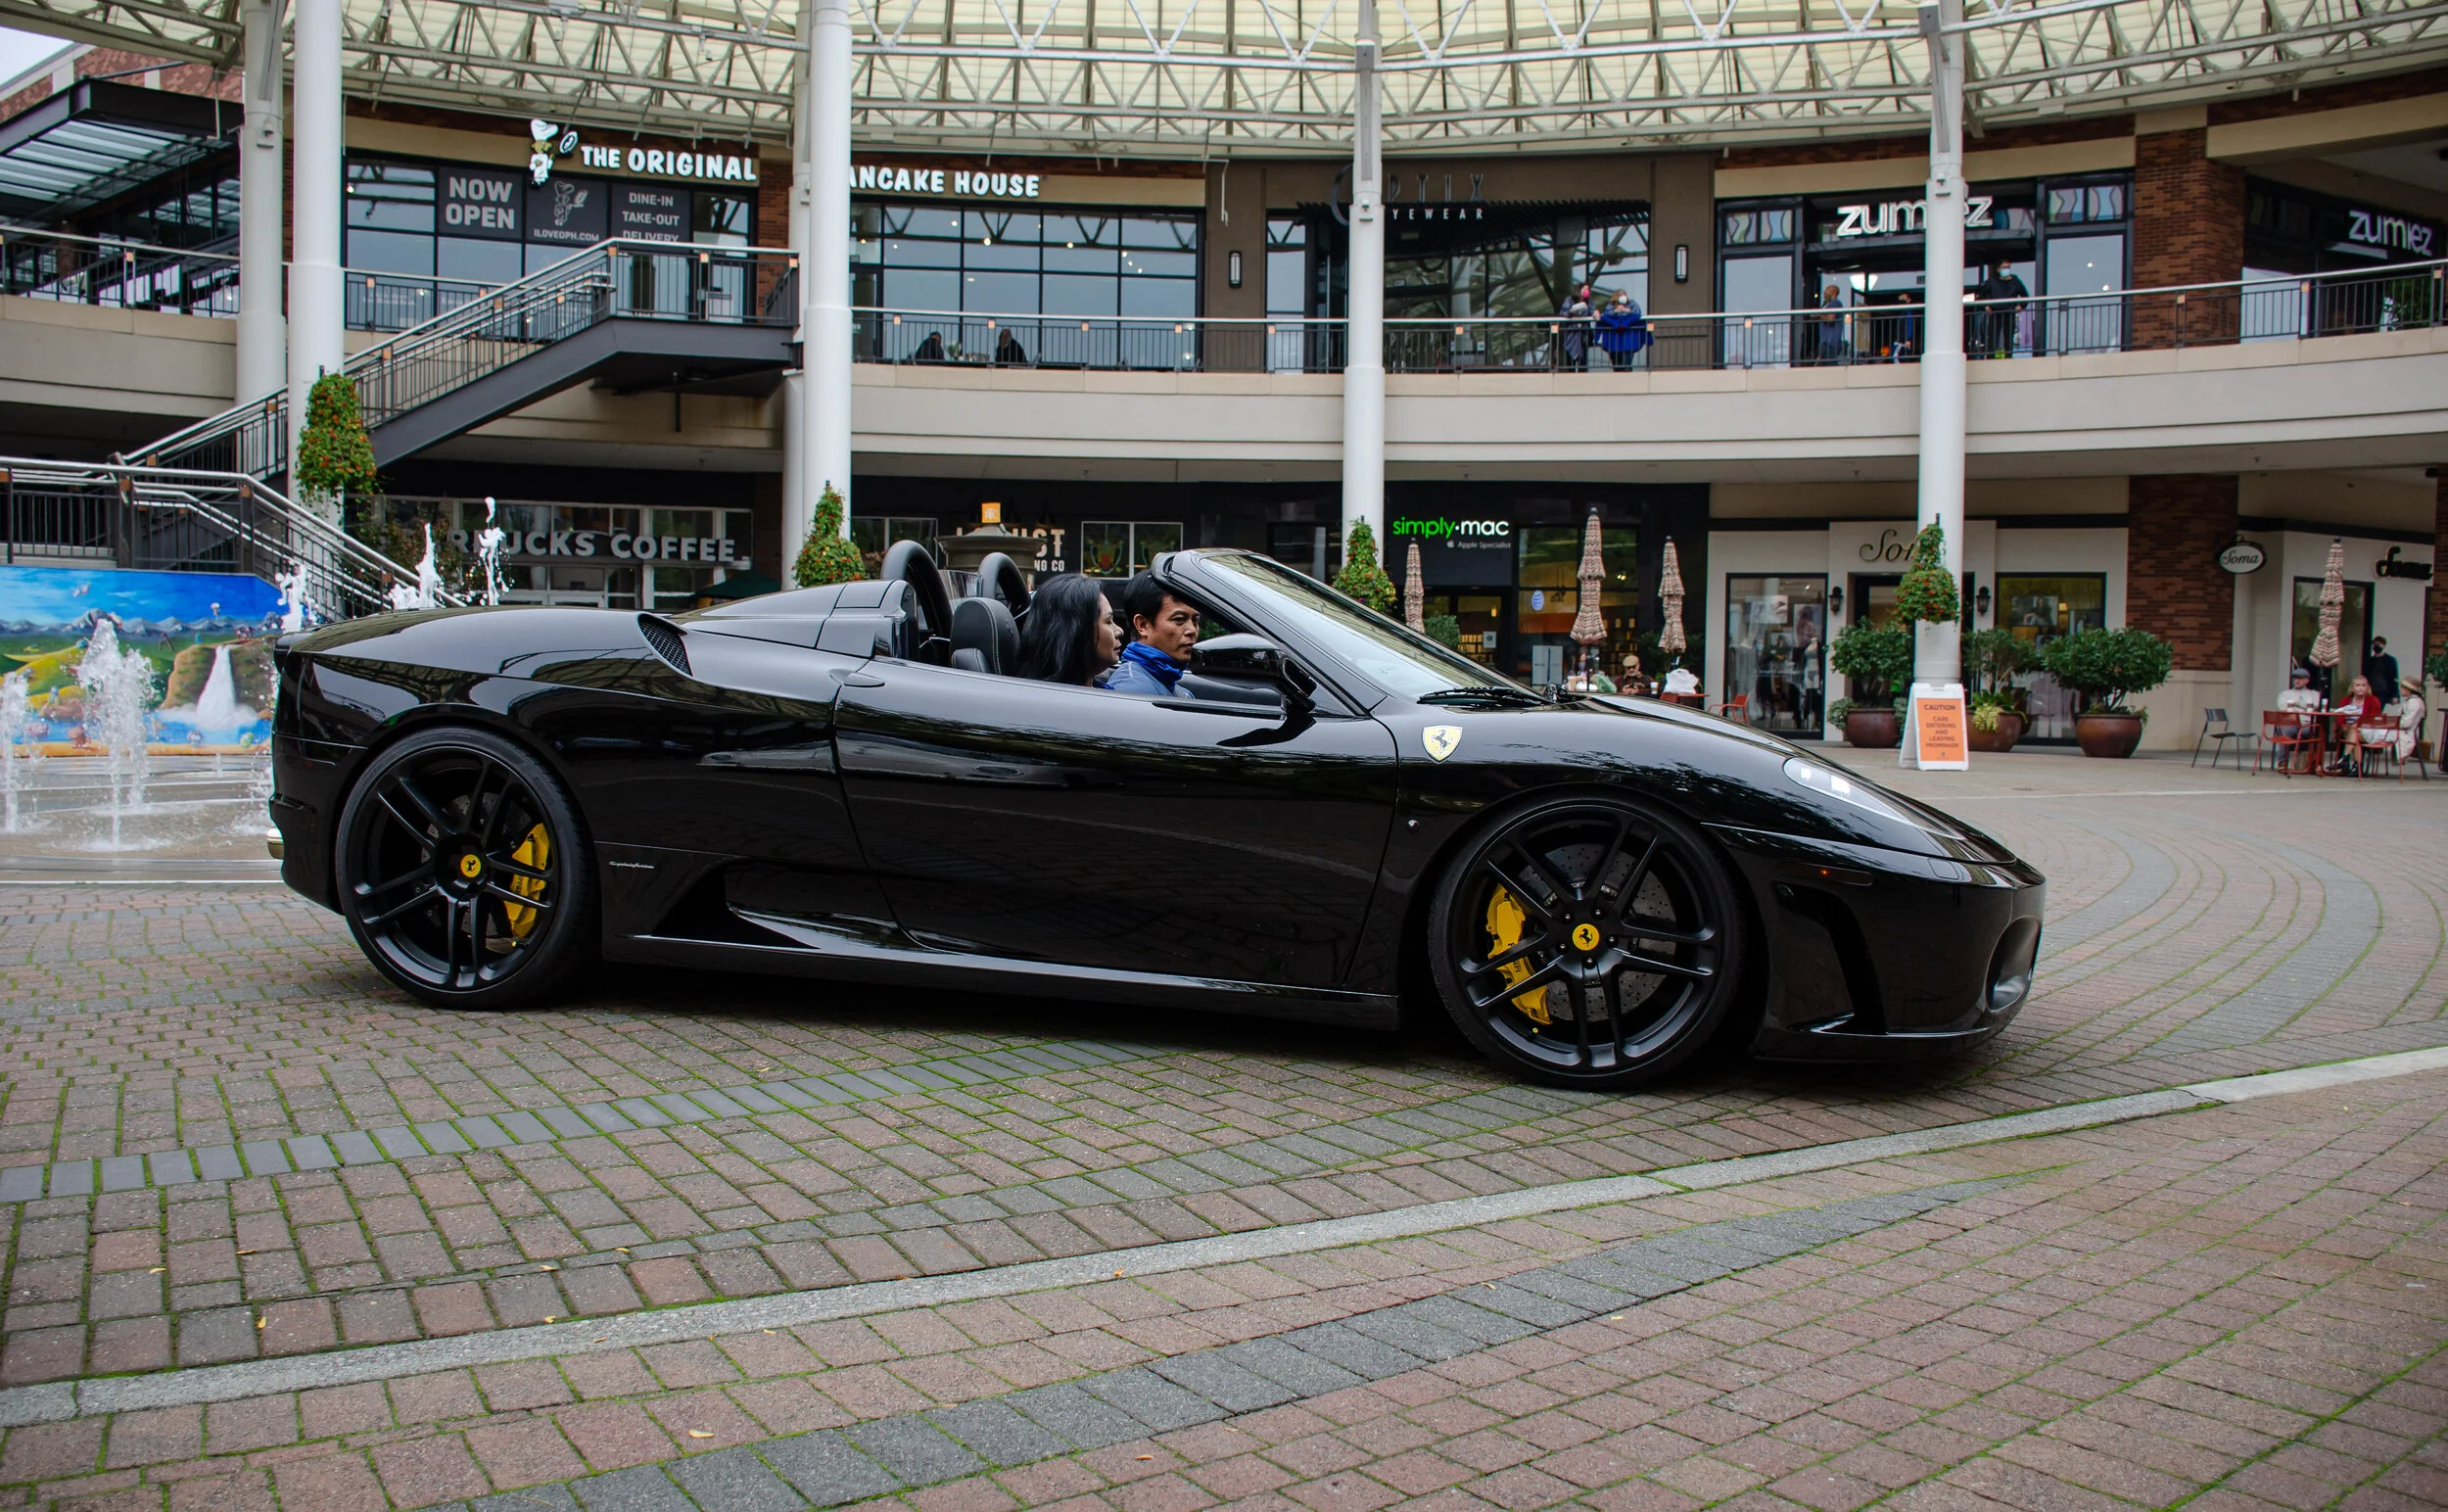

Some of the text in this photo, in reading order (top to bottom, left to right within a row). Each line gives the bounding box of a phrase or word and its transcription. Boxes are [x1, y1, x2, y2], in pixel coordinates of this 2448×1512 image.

[581, 146, 1040, 198] THE ORIGINAL ANCAKE HOUSE
[448, 177, 513, 203] NOW
[629, 192, 674, 208] DINE-IN
[446, 203, 515, 229] OPEN
[622, 211, 681, 226] TAKE-OUT
[1392, 209, 1483, 220] YEWEAR
[1836, 196, 1994, 237] zumz
[534, 228, 599, 242] ILOVEOPH.COM
[2348, 210, 2432, 257] zumiez
[610, 533, 735, 562] COFFEE
[1859, 529, 1915, 562] So
[2222, 548, 2260, 565] Soma
